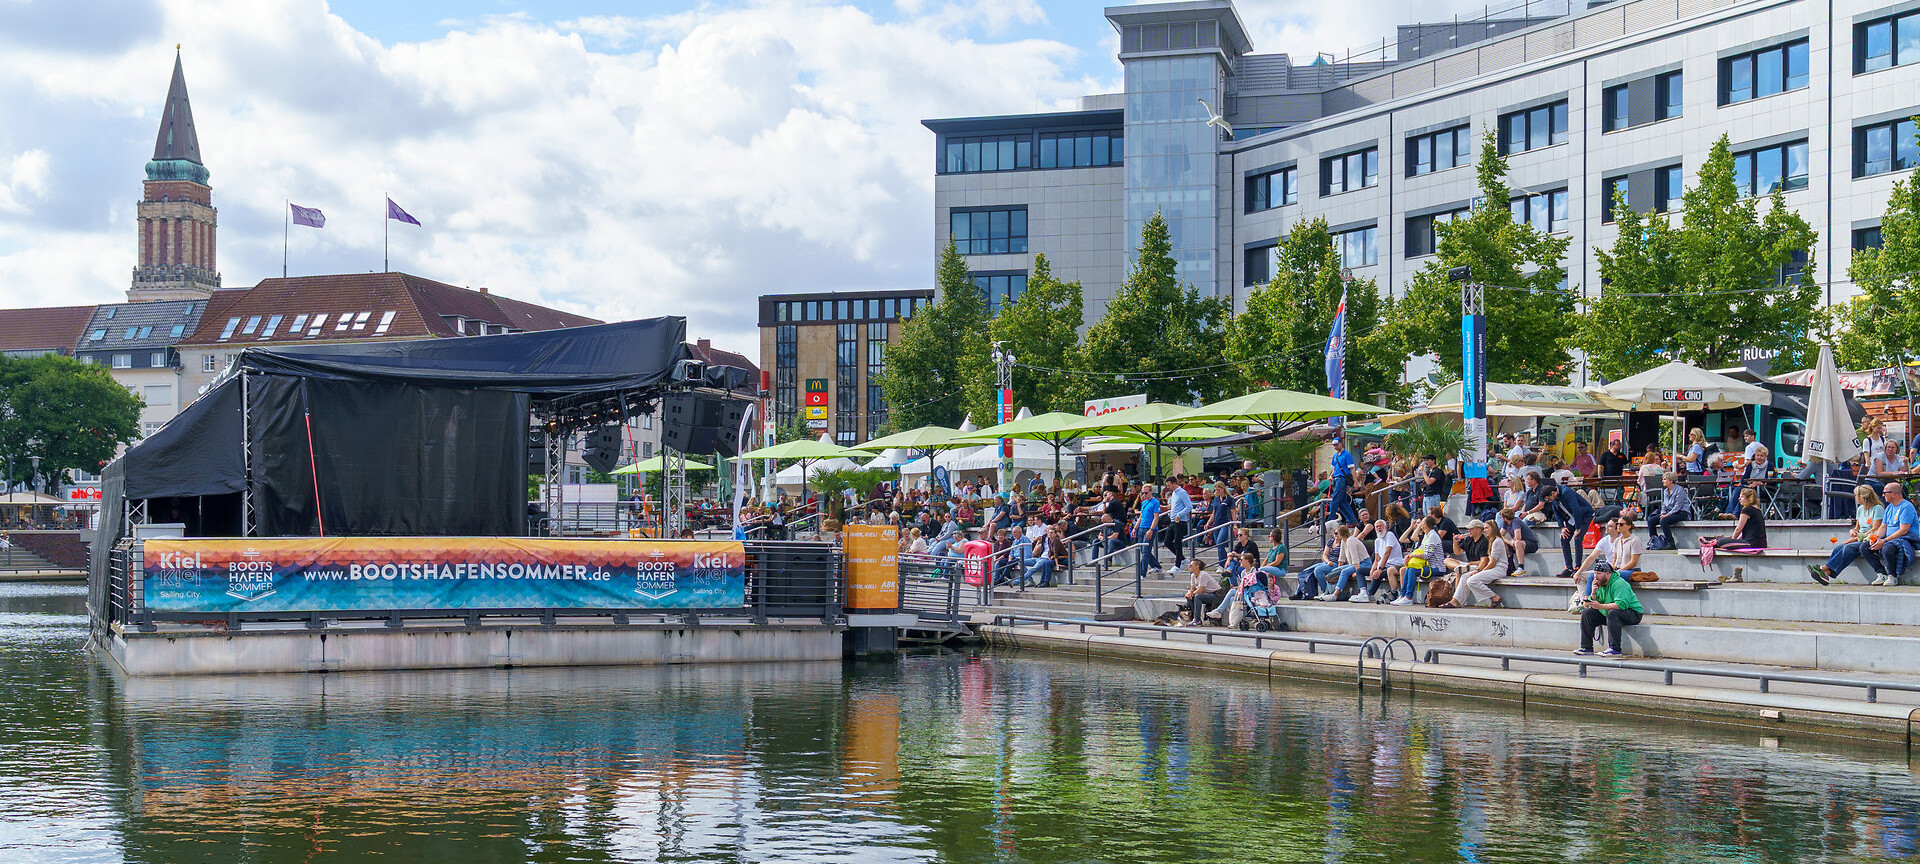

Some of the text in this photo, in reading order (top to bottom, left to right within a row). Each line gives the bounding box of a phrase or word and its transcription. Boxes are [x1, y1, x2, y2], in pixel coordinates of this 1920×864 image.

[1664, 389, 1702, 401] CUP&CINO
[882, 529, 896, 537] ABK
[229, 561, 273, 572] BOOTS
[303, 562, 611, 582] www.BOOTSHAFENSOMMER.de
[637, 561, 675, 572] BOOTS
[229, 572, 273, 583] HAFEN
[637, 571, 675, 581] HAFEN
[229, 582, 273, 592] SOMMER
[636, 581, 675, 590] SOMMER
